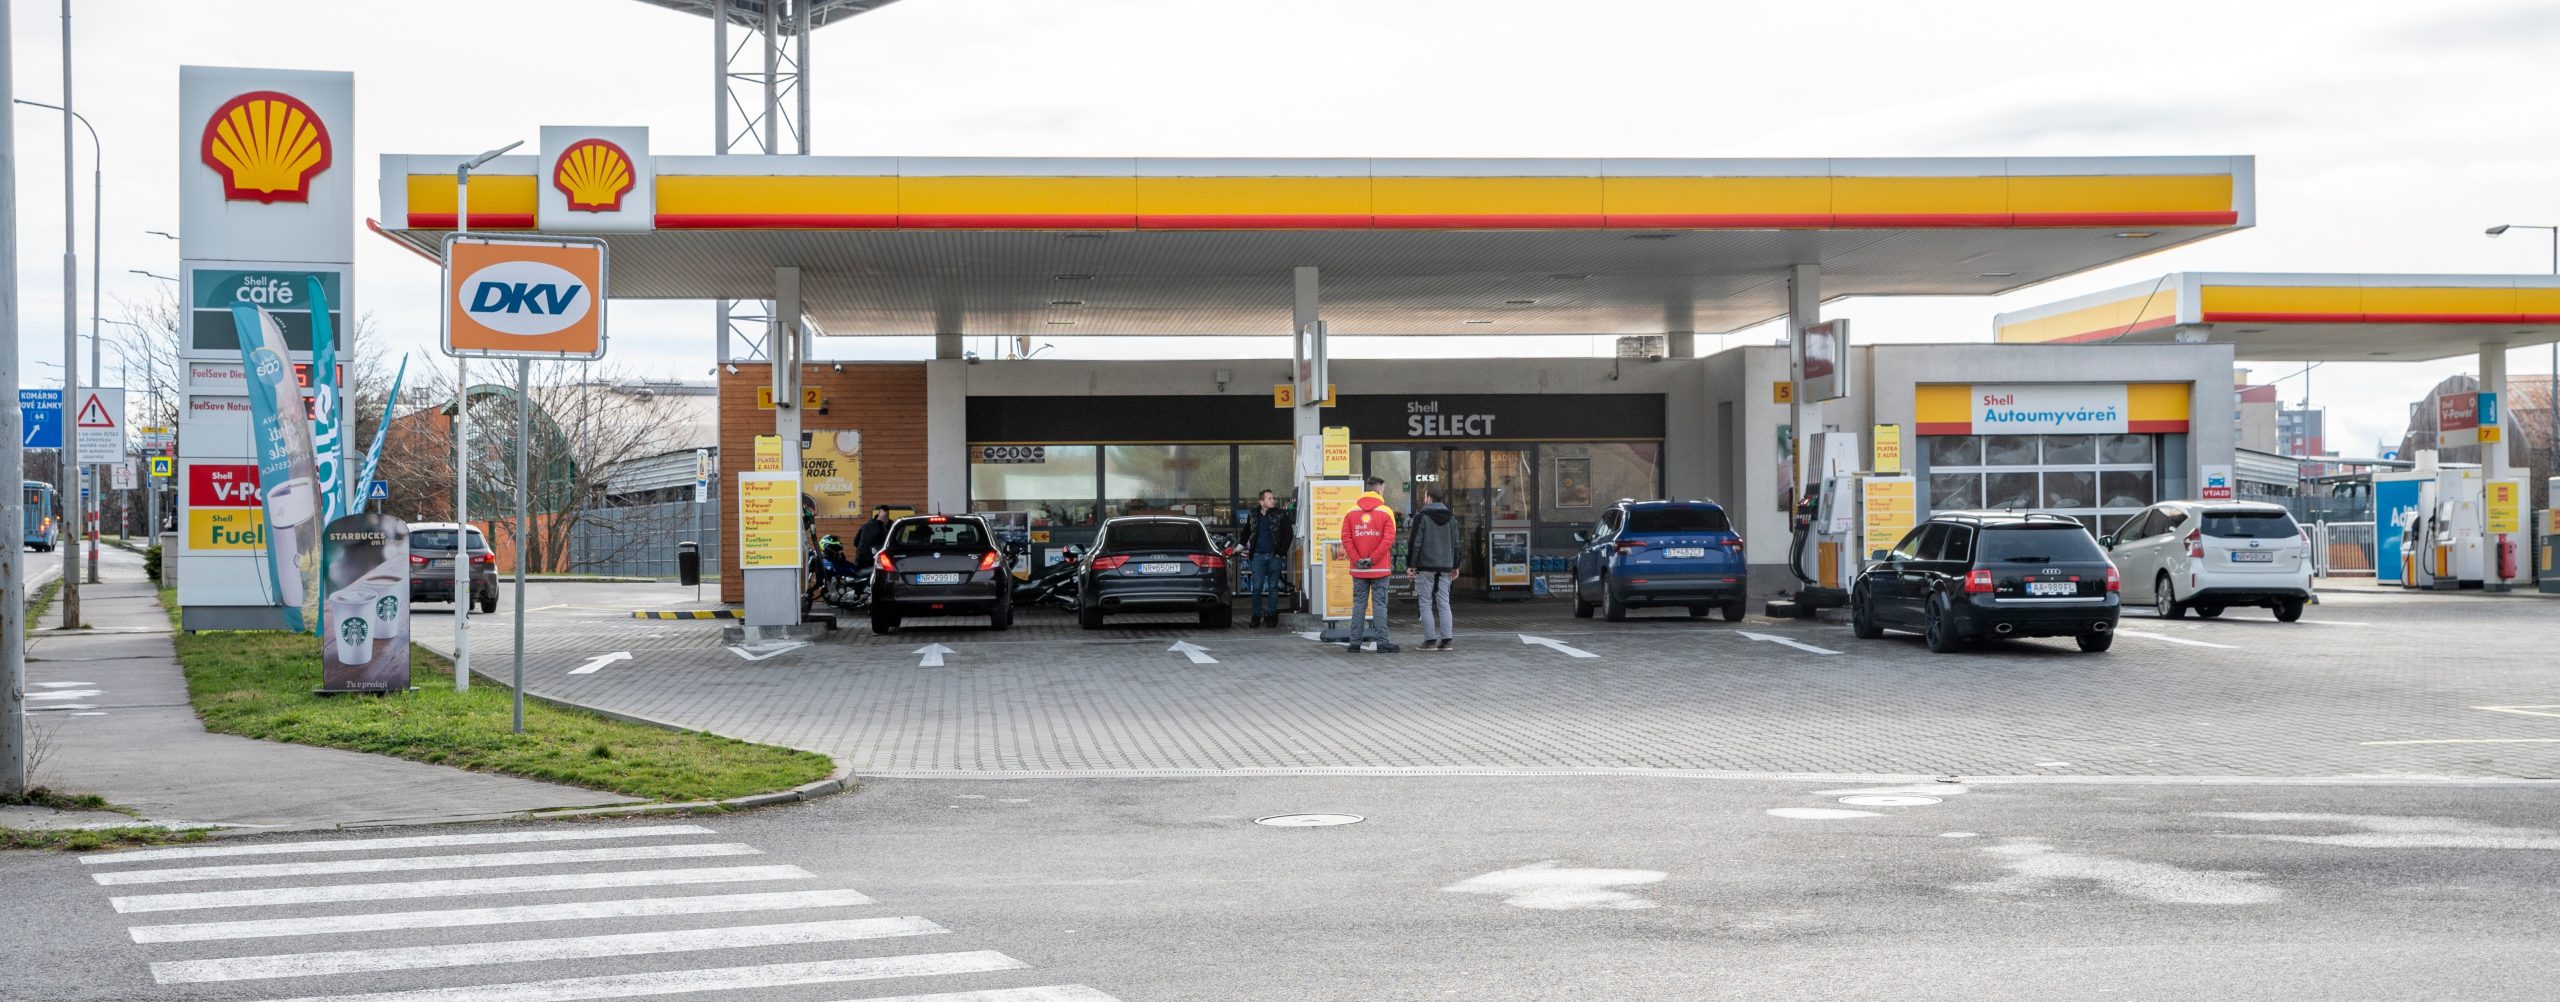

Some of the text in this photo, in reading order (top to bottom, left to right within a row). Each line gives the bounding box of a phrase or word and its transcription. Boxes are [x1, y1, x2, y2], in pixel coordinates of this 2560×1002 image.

[244, 276, 267, 286] Shell
[236, 280, 294, 304] café
[470, 281, 583, 315] DKV
[192, 369, 226, 379] FuelSave
[20, 390, 58, 400] KOMÁRNO
[807, 391, 816, 403] 2
[1281, 390, 1290, 402] 3
[1780, 386, 1789, 398] 5
[766, 392, 772, 404] 1
[1984, 394, 2014, 406] Shell
[20, 400, 62, 409] OVÉ ZÁMKY
[190, 401, 224, 411] FuelSave
[1408, 401, 1438, 413] Shell
[1984, 406, 2116, 426] Autoumyváreň
[1408, 414, 1496, 436] SELECT
[2484, 430, 2490, 438] 7
[212, 472, 232, 480] Shell
[806, 469, 838, 477] ROAST
[330, 532, 386, 540] STARBUCKS
[362, 681, 388, 689] predaji
